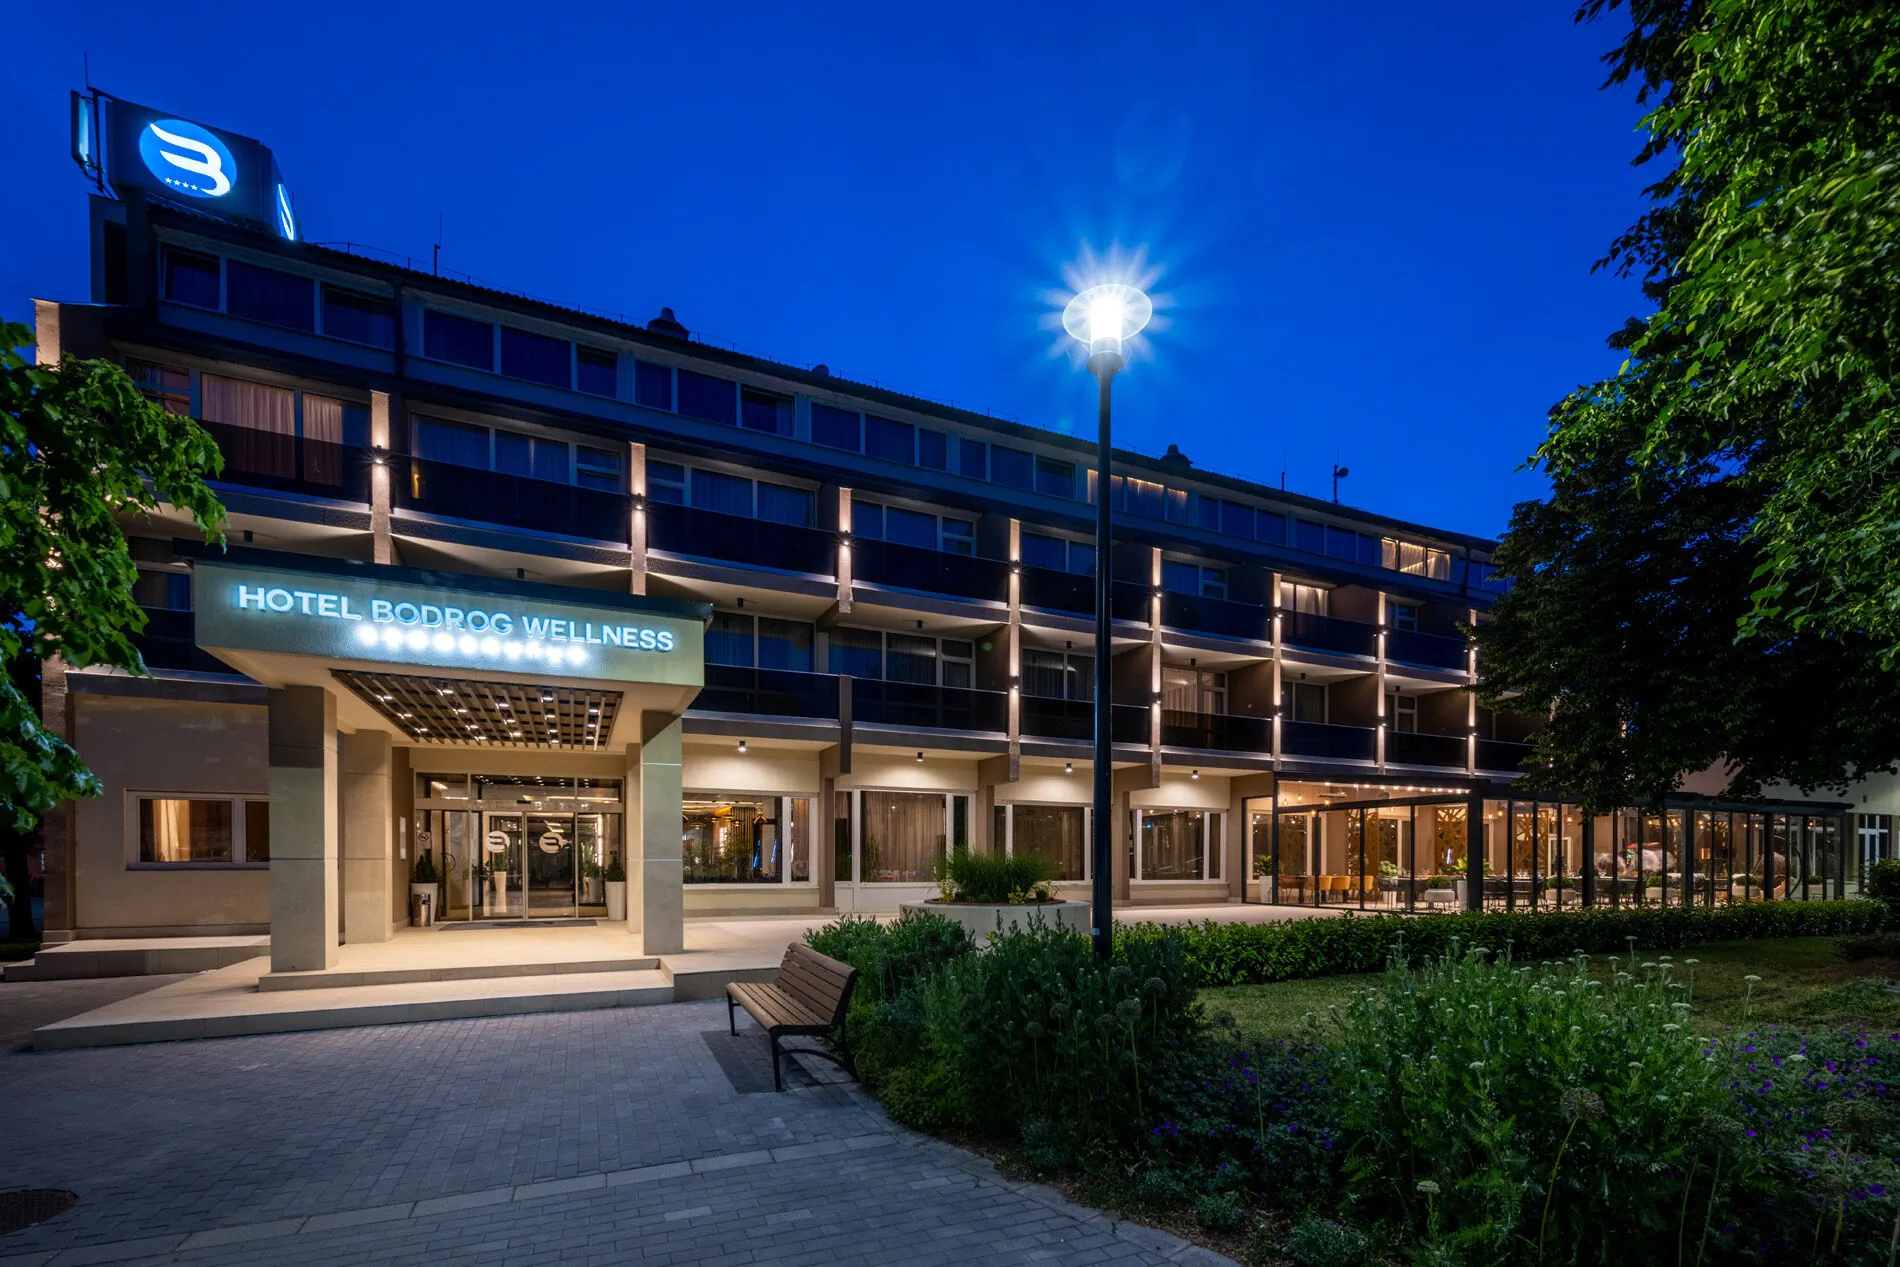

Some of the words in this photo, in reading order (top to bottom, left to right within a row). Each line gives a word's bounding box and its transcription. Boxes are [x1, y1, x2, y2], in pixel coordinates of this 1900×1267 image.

[238, 584, 361, 621] HOTEL
[371, 599, 513, 636] BODROG
[522, 615, 674, 653] WELLNESS
